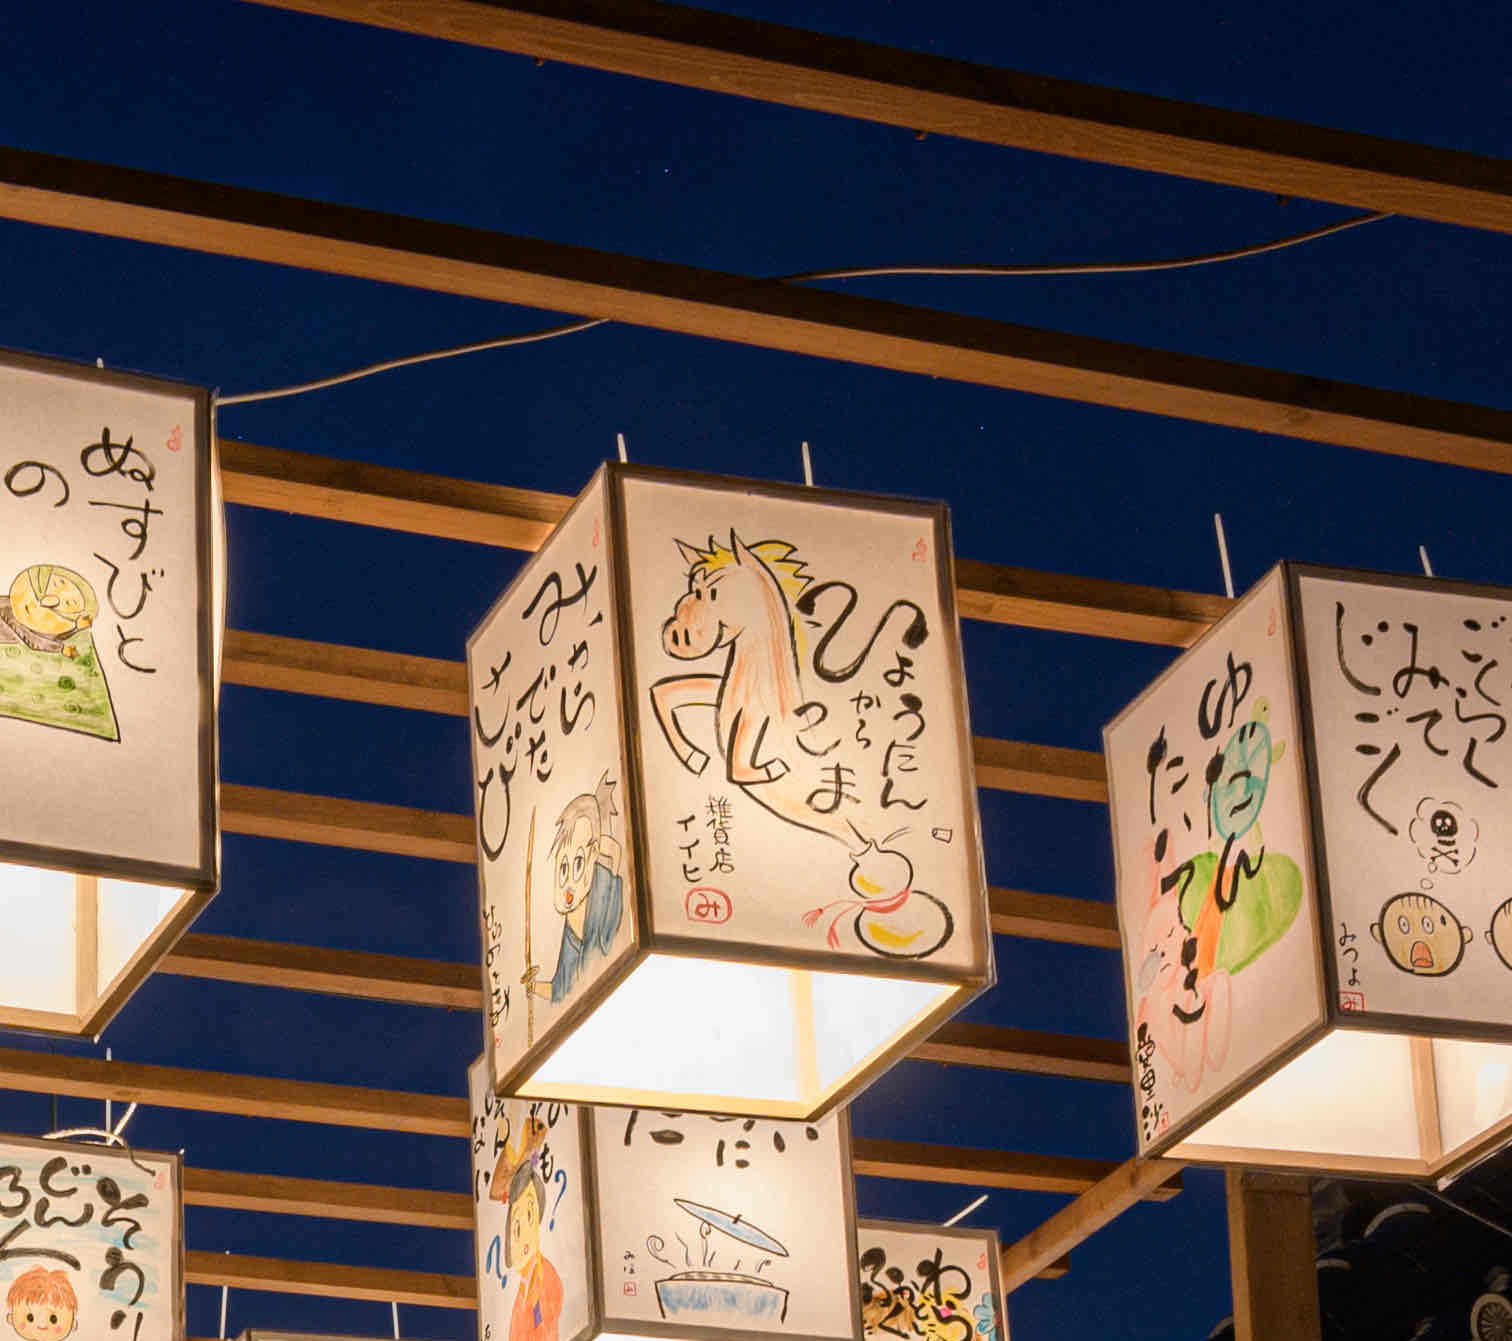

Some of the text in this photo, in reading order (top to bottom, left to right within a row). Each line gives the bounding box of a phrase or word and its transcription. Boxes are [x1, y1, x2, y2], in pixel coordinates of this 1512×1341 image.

[80, 426, 166, 674] ぬすびと
[1335, 600, 1401, 836] じごく
